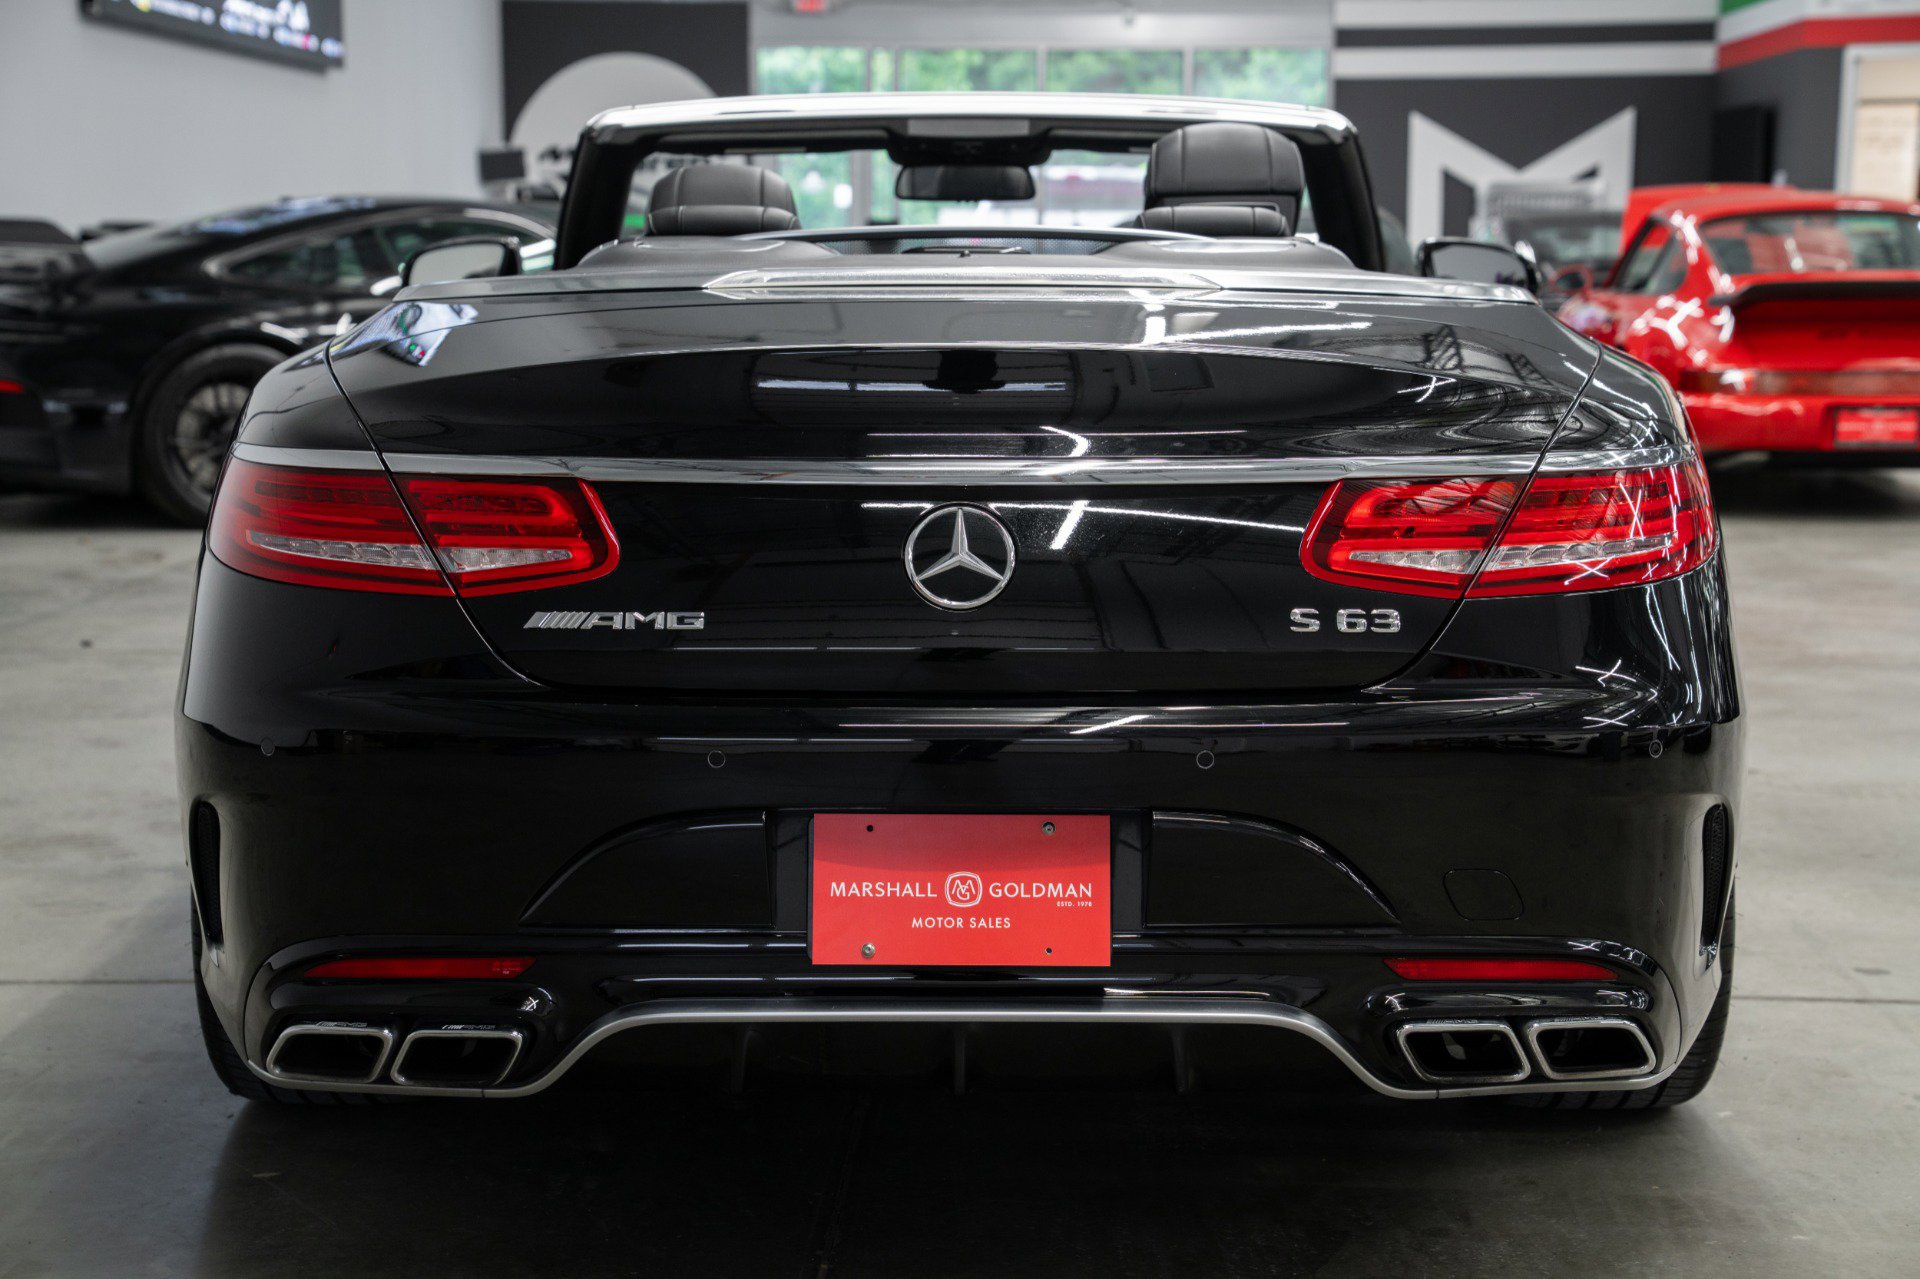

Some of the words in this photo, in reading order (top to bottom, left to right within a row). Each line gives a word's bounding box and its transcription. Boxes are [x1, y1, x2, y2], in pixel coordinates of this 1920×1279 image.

[1290, 608, 1320, 632] S
[1336, 608, 1401, 633] 63
[830, 881, 938, 898] MARSHALL
[989, 882, 1092, 898] GOLDMAN
[911, 917, 964, 929] MOTOR
[969, 917, 1011, 929] SALES
